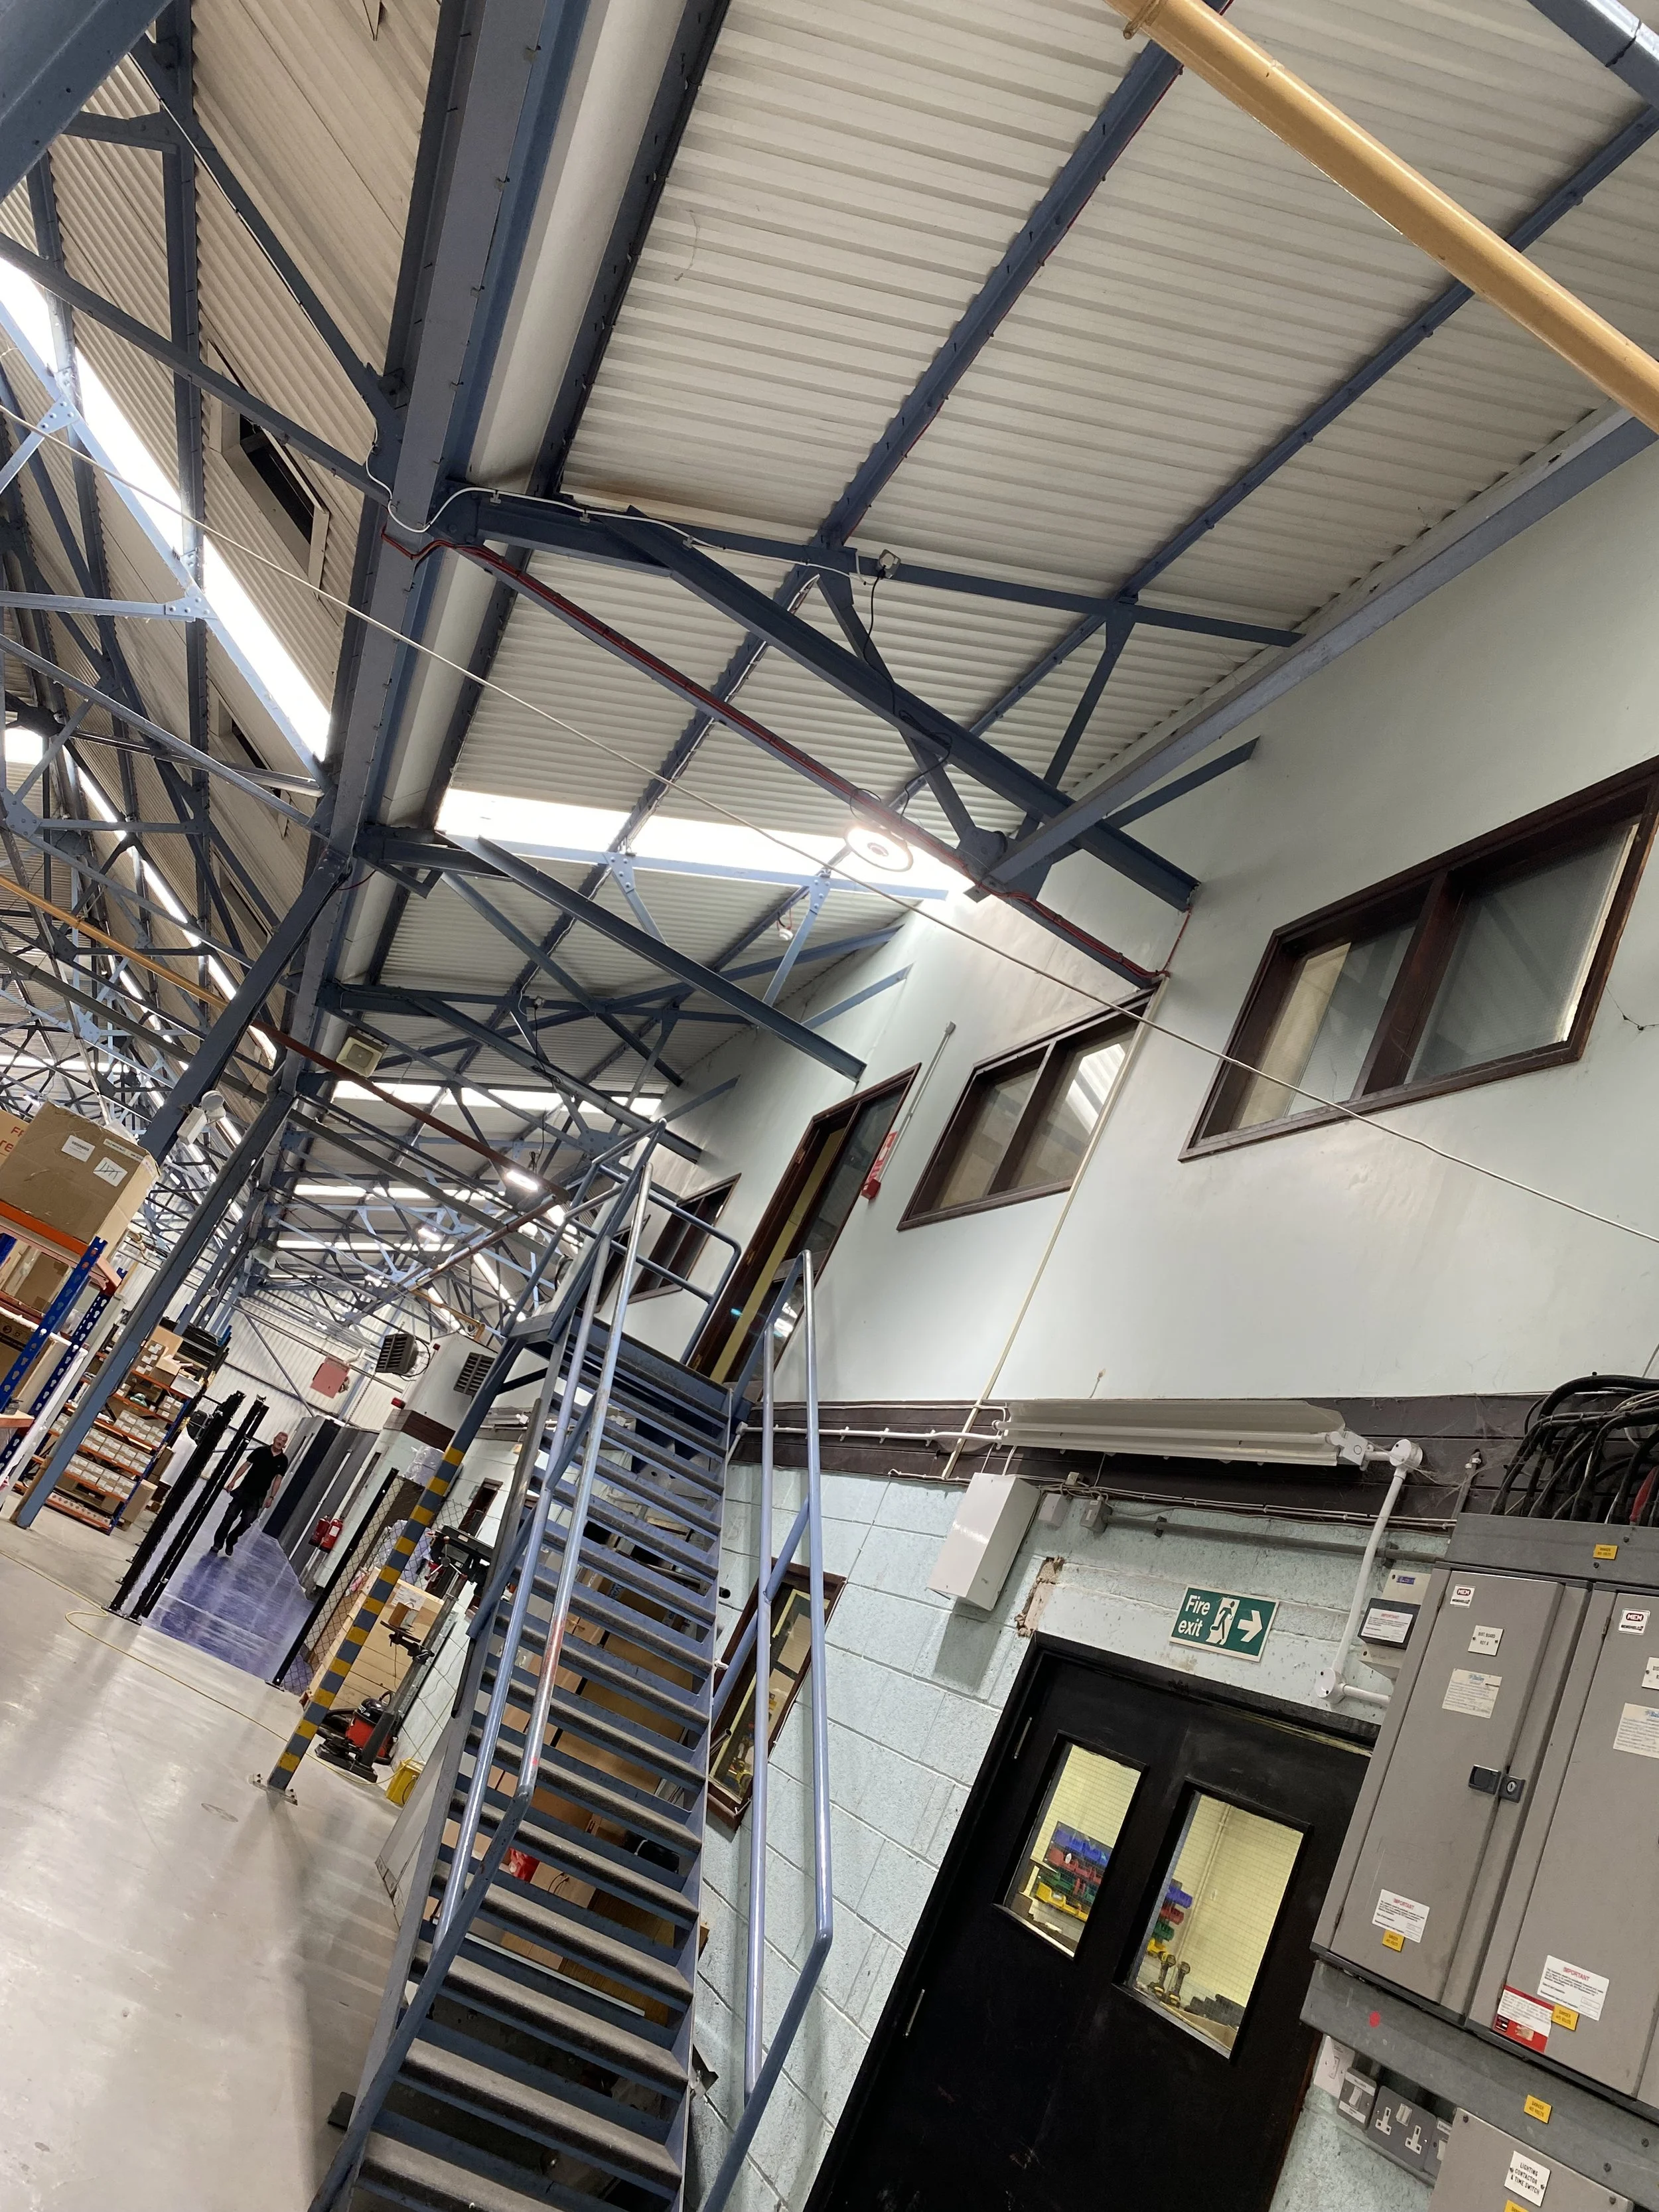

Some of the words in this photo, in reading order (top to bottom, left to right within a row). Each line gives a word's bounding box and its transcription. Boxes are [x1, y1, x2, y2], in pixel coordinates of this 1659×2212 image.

[1185, 1595, 1210, 1615] Fire
[1626, 1613, 1644, 1621] MEM
[1178, 1619, 1204, 1637] exit
[1394, 1898, 1414, 1909] IMPORTANT
[1563, 1967, 1589, 1981] IMPORTANT
[1532, 2101, 1544, 2110] DANGER
[1534, 2108, 1544, 2118] VOLTS
[1514, 2168, 1538, 2185] CONTACTOR
[1520, 2162, 1538, 2177] LIGHTING
[1514, 2177, 1524, 2188] TIME
[1524, 2181, 1540, 2195] SWITCH
